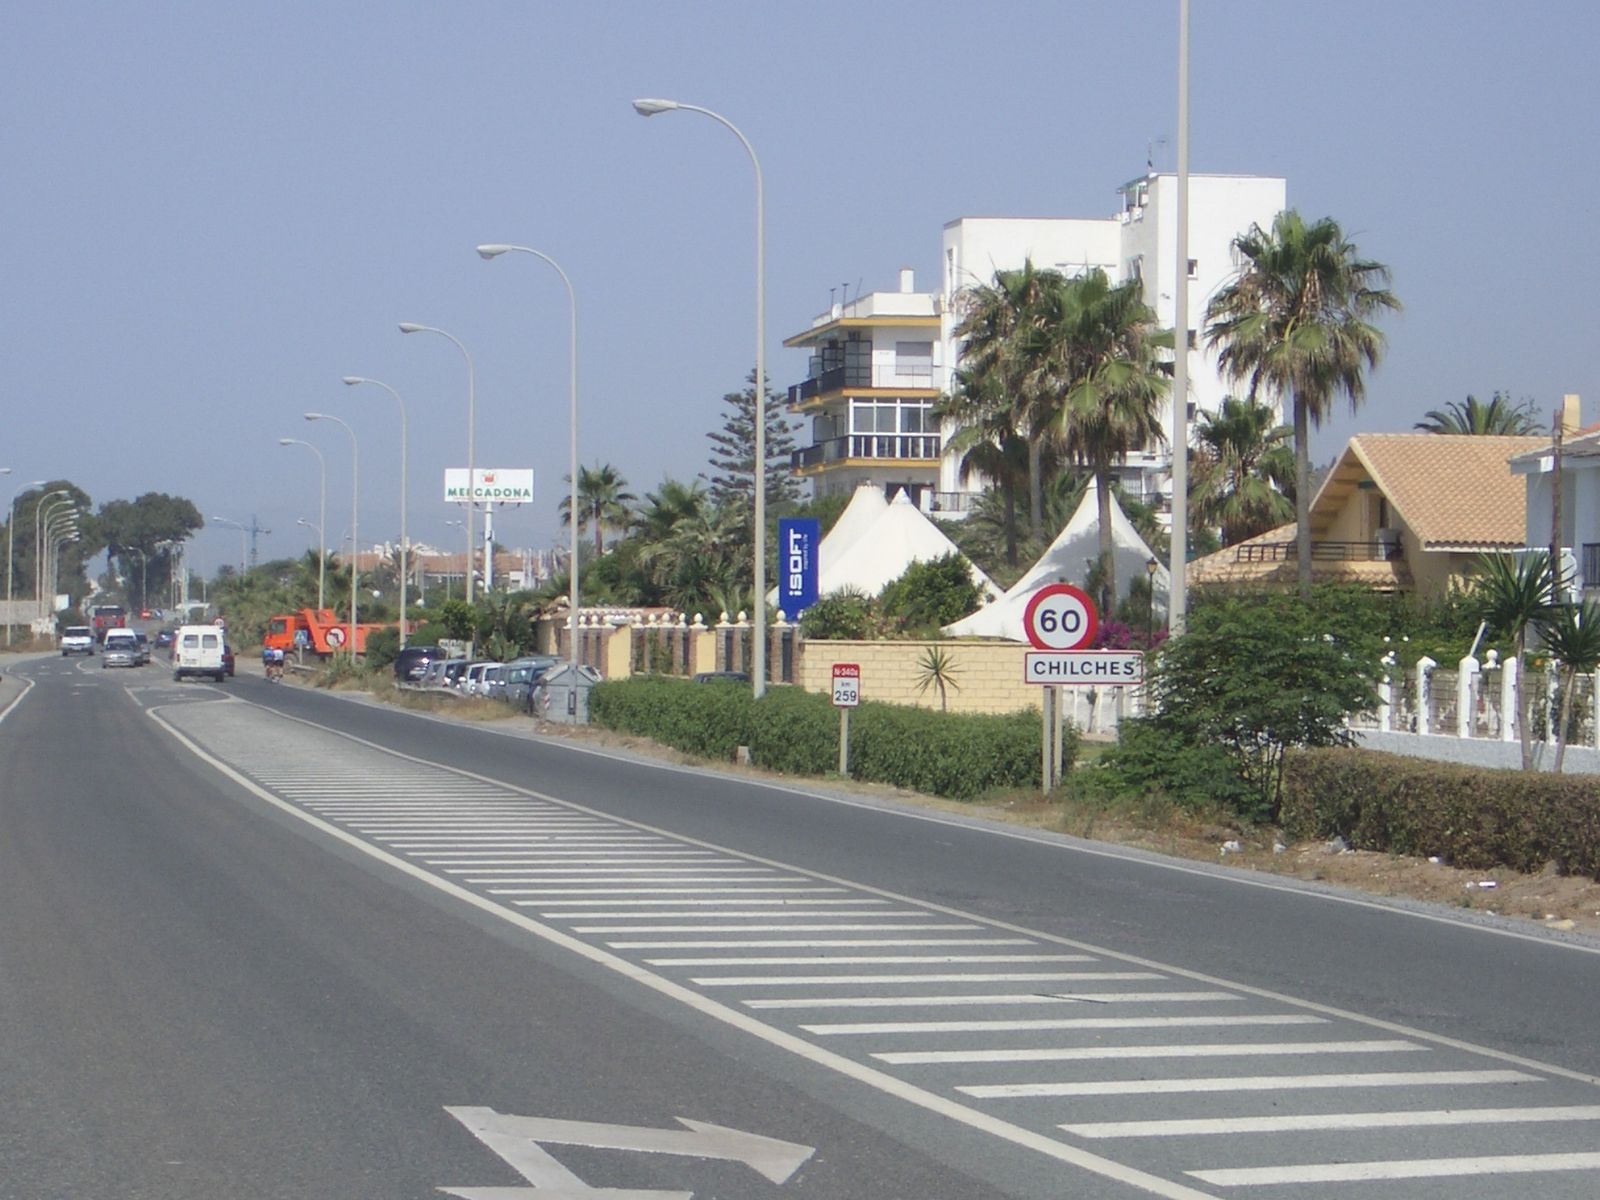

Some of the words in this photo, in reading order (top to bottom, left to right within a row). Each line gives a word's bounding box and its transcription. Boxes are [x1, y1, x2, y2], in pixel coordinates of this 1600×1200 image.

[1040, 609, 1081, 633] 60
[1033, 661, 1136, 675] CHILCHES
[835, 690, 857, 702] 259
